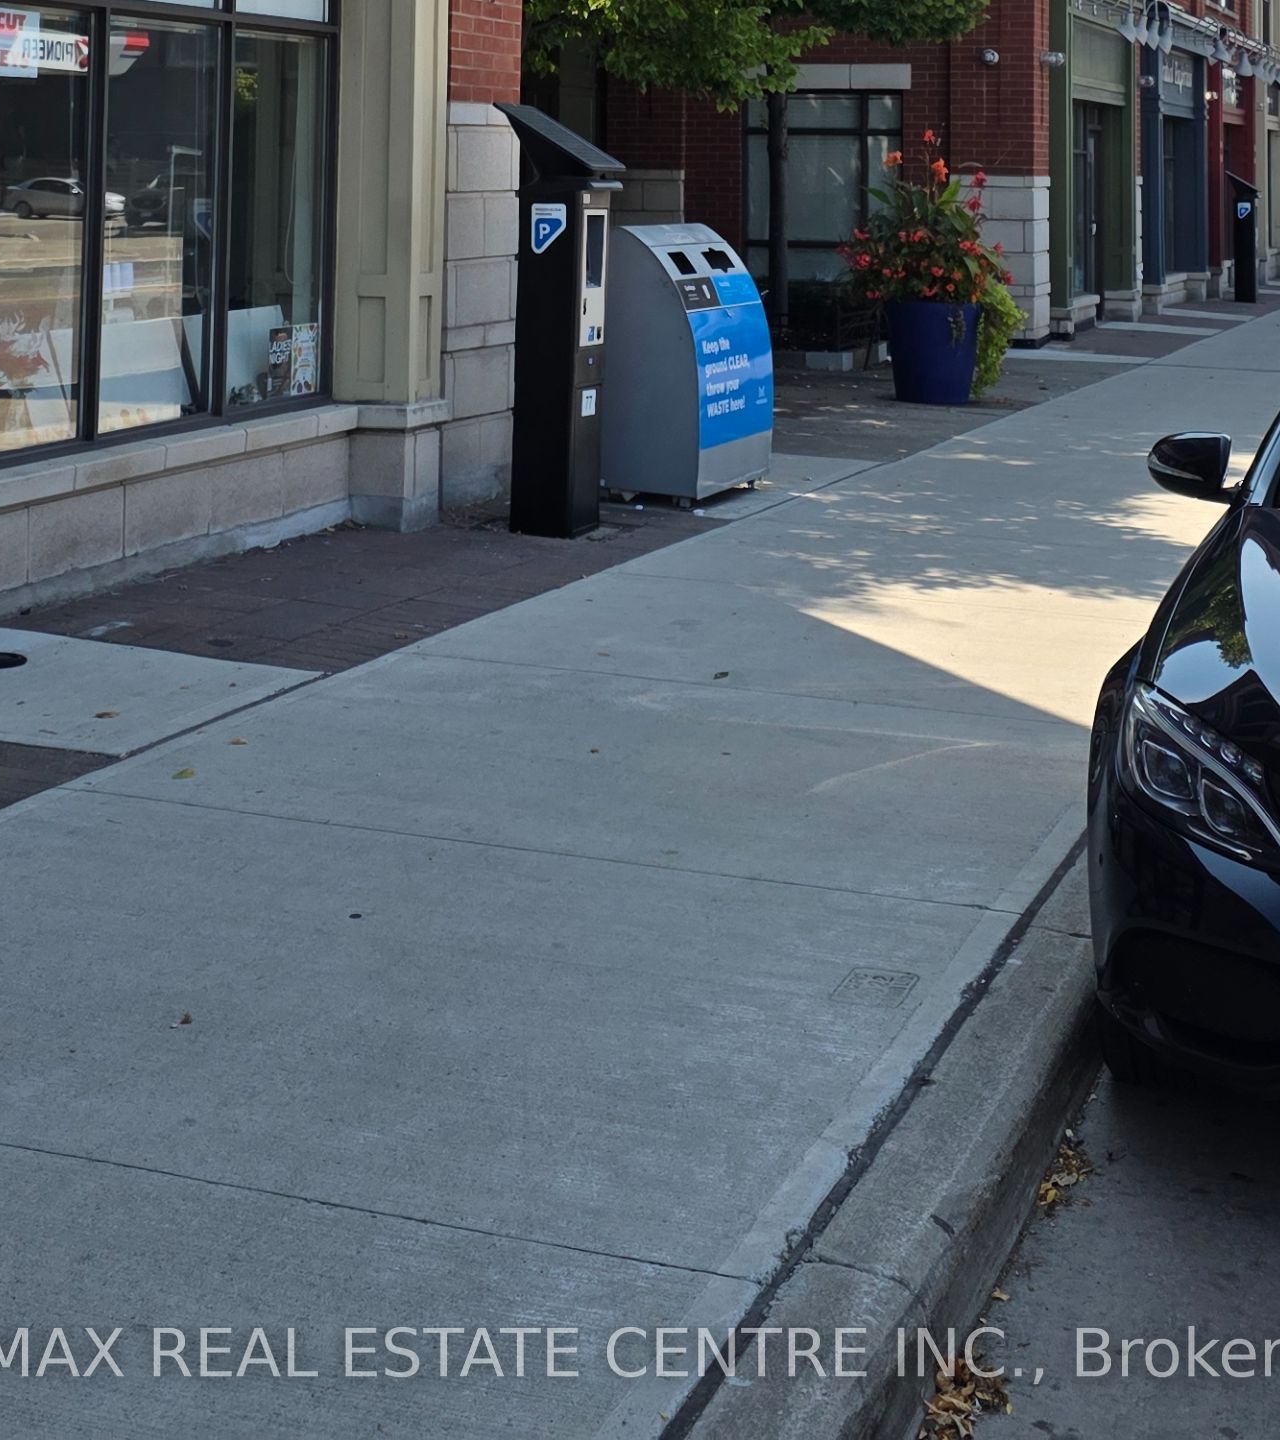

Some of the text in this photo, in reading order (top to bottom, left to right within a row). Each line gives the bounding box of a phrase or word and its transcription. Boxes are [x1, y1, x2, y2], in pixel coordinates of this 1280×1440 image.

[539, 223, 551, 240] P
[702, 336, 730, 355] Keep the
[705, 359, 729, 379] ground
[706, 378, 740, 397] throw your
[707, 395, 746, 418] WASTE here!
